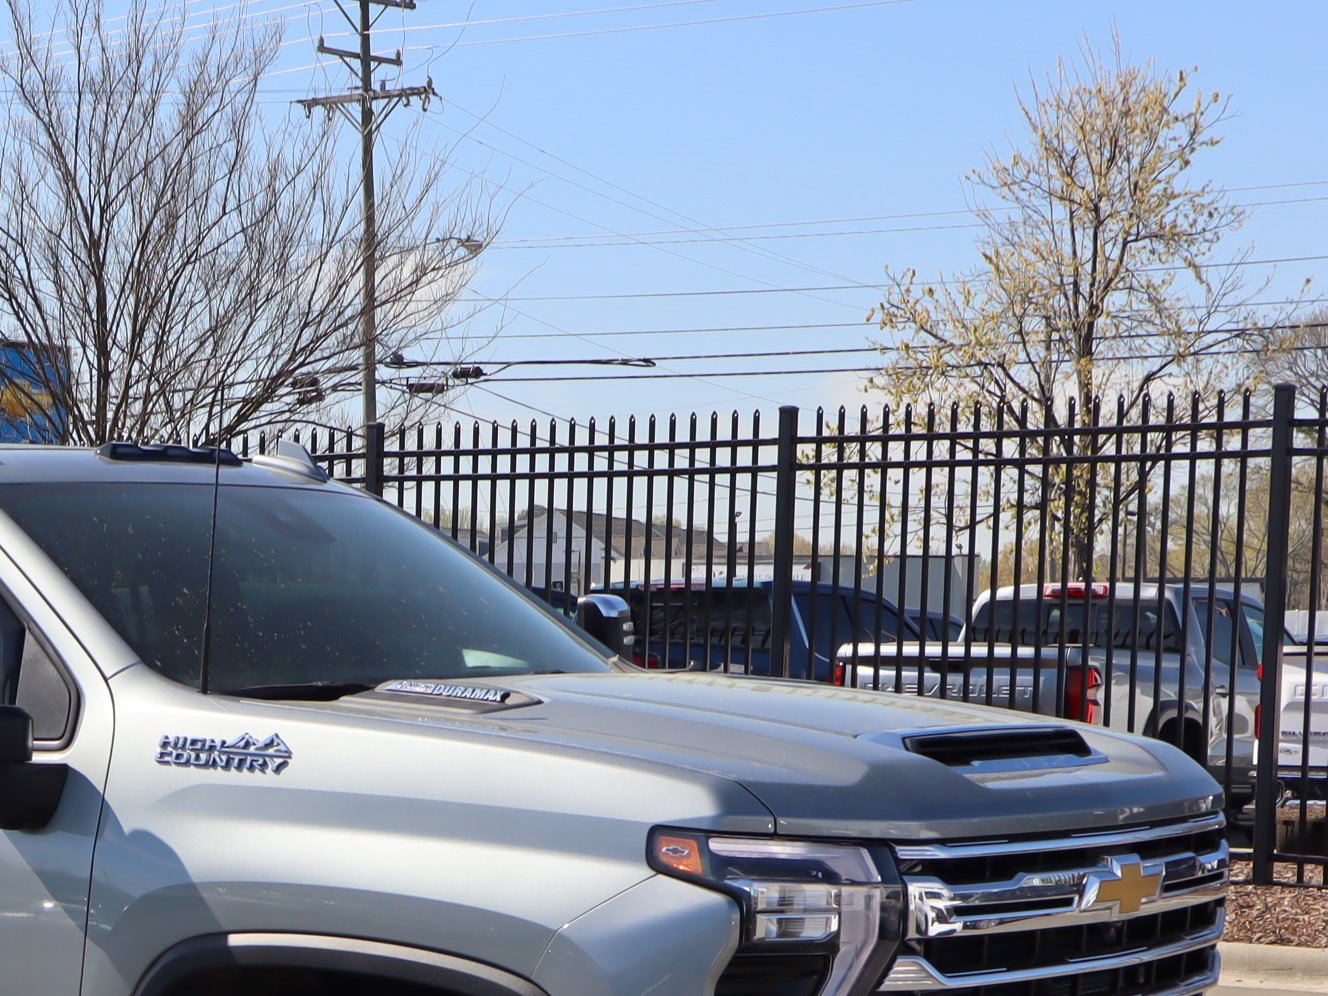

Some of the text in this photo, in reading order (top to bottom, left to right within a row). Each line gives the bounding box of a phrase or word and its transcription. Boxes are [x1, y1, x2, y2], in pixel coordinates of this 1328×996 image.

[432, 684, 504, 702] DURAMAX
[159, 734, 227, 751] HIGH
[154, 749, 290, 775] COUNTRY
